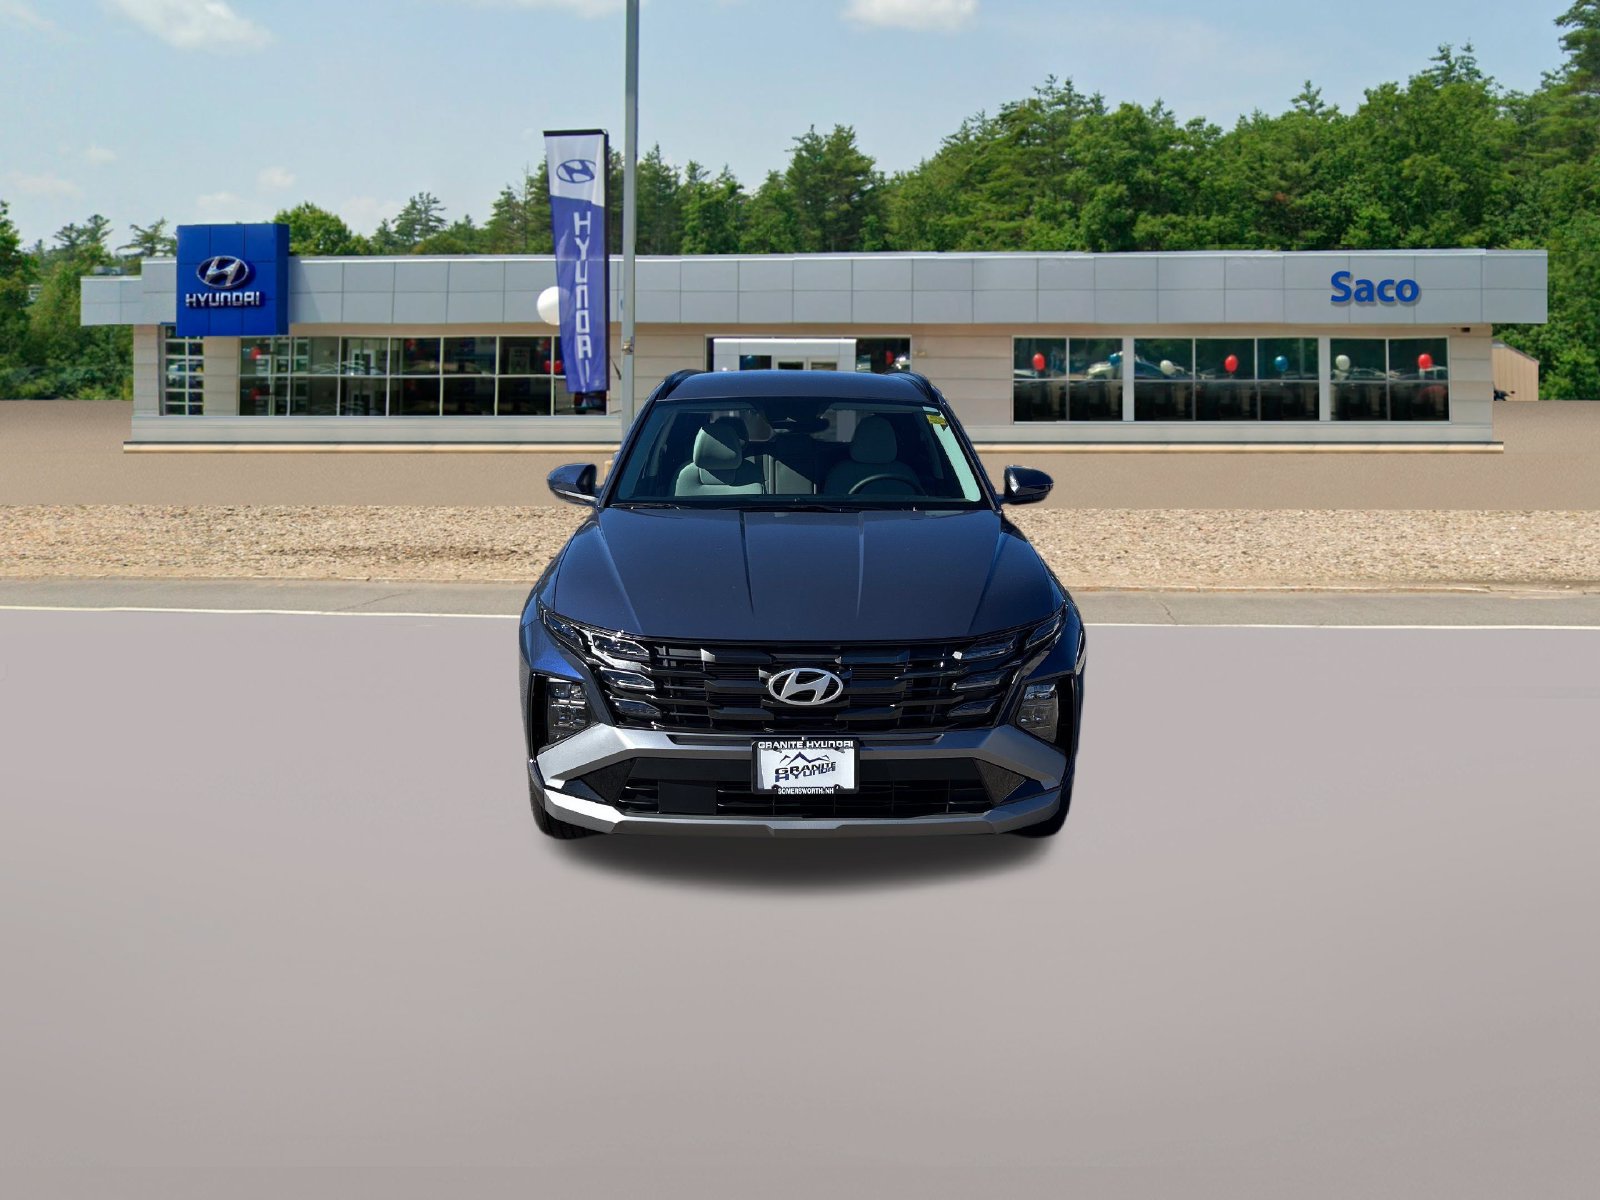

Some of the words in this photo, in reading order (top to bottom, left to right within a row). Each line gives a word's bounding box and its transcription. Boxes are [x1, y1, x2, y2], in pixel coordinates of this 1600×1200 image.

[1330, 270, 1420, 303] Saco
[185, 291, 261, 308] HYUNDAI
[573, 210, 593, 384] HYUNDAI
[757, 741, 804, 749] GRANITE
[806, 740, 854, 748] HYUNDAI
[774, 761, 837, 775] GRANITE
